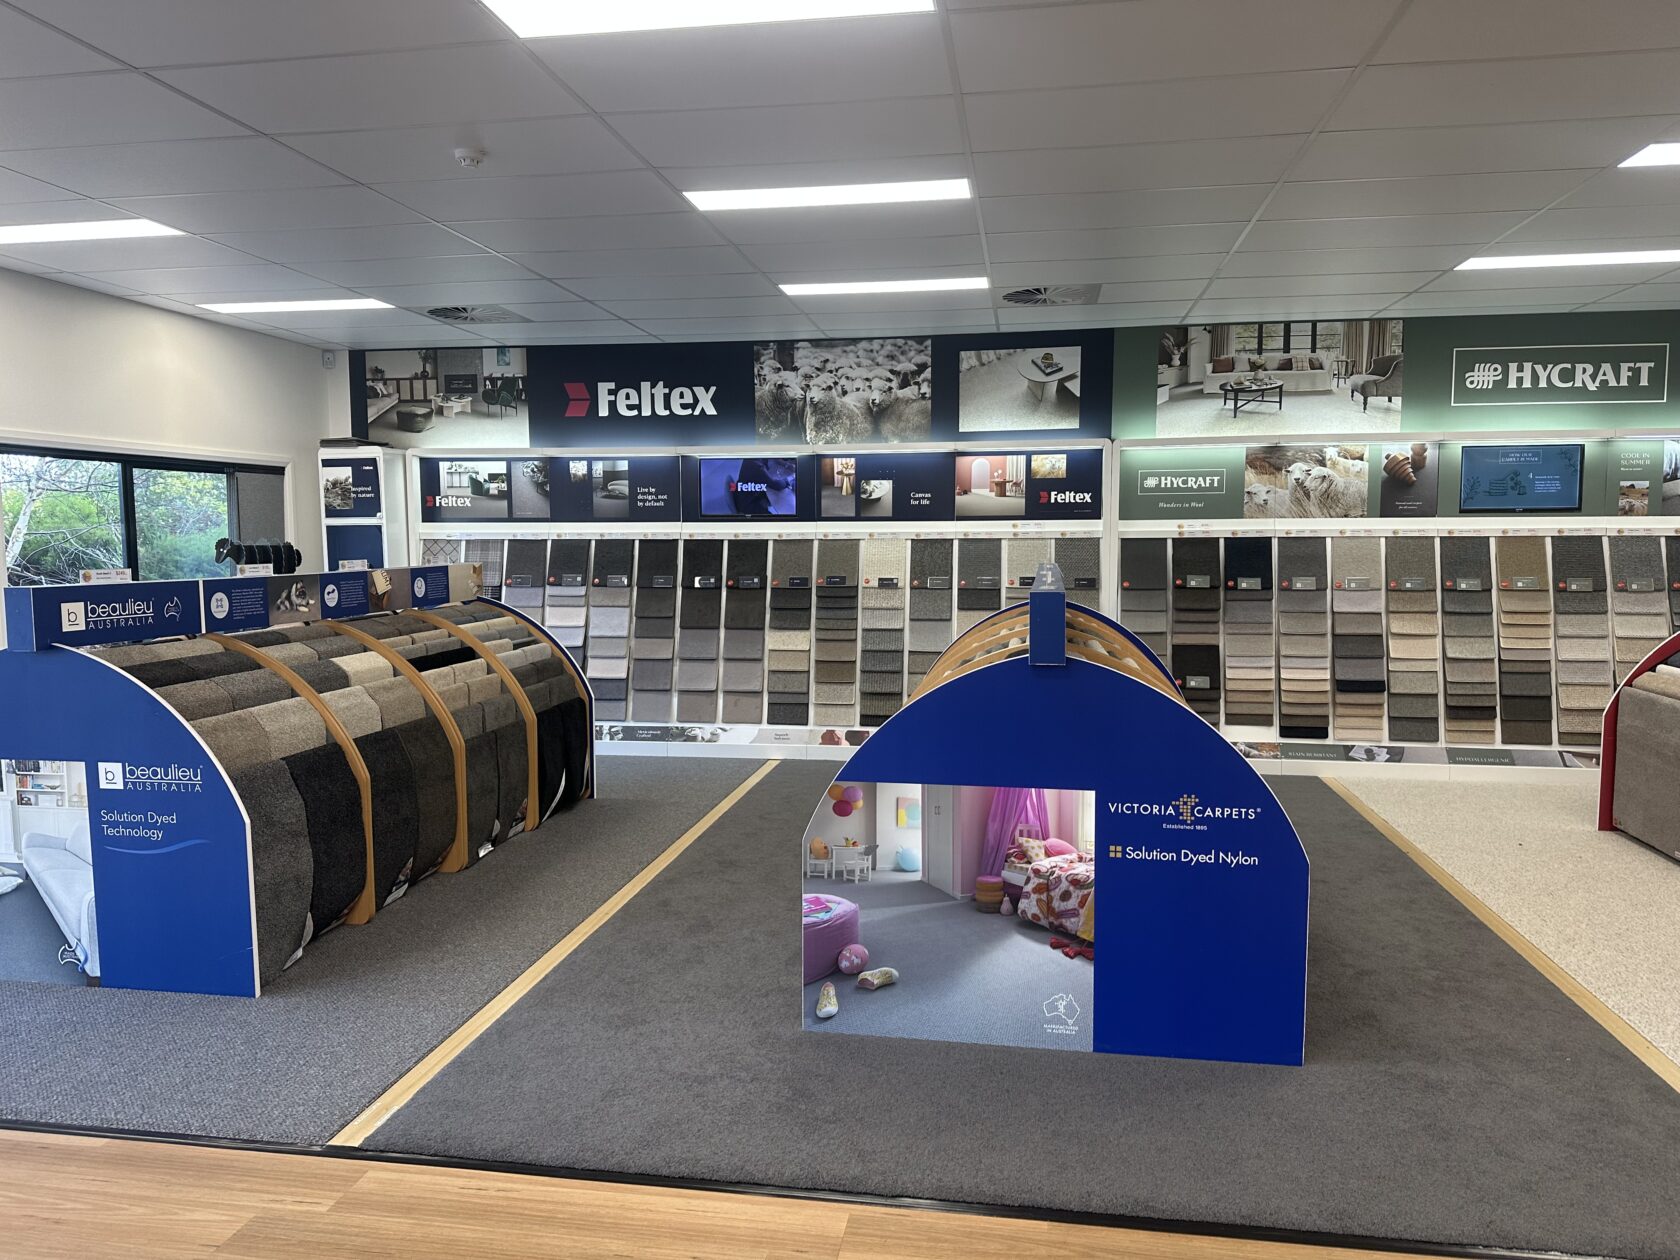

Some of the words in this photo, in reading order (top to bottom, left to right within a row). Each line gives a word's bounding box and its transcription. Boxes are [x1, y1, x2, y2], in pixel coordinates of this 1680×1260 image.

[1507, 361, 1655, 391] HYCRAFT
[597, 380, 718, 417] Feltex
[737, 482, 768, 492] Feltex
[1160, 476, 1220, 489] HYCRAFT
[649, 486, 656, 494] by
[1050, 491, 1092, 503] Feltex
[435, 495, 472, 507] Feltex
[87, 598, 153, 618] beaulieu
[88, 616, 154, 630] AUSTRALIA
[125, 762, 201, 781] beaulieu
[126, 782, 202, 793] AUSTRALIA
[1108, 802, 1176, 816] VICTORIA
[100, 809, 145, 823] Solution
[147, 811, 177, 826] Dyed
[101, 824, 164, 841] Technology
[1125, 846, 1177, 862] Solution
[1181, 849, 1215, 866] Dyed
[1219, 850, 1259, 868] Nylon
